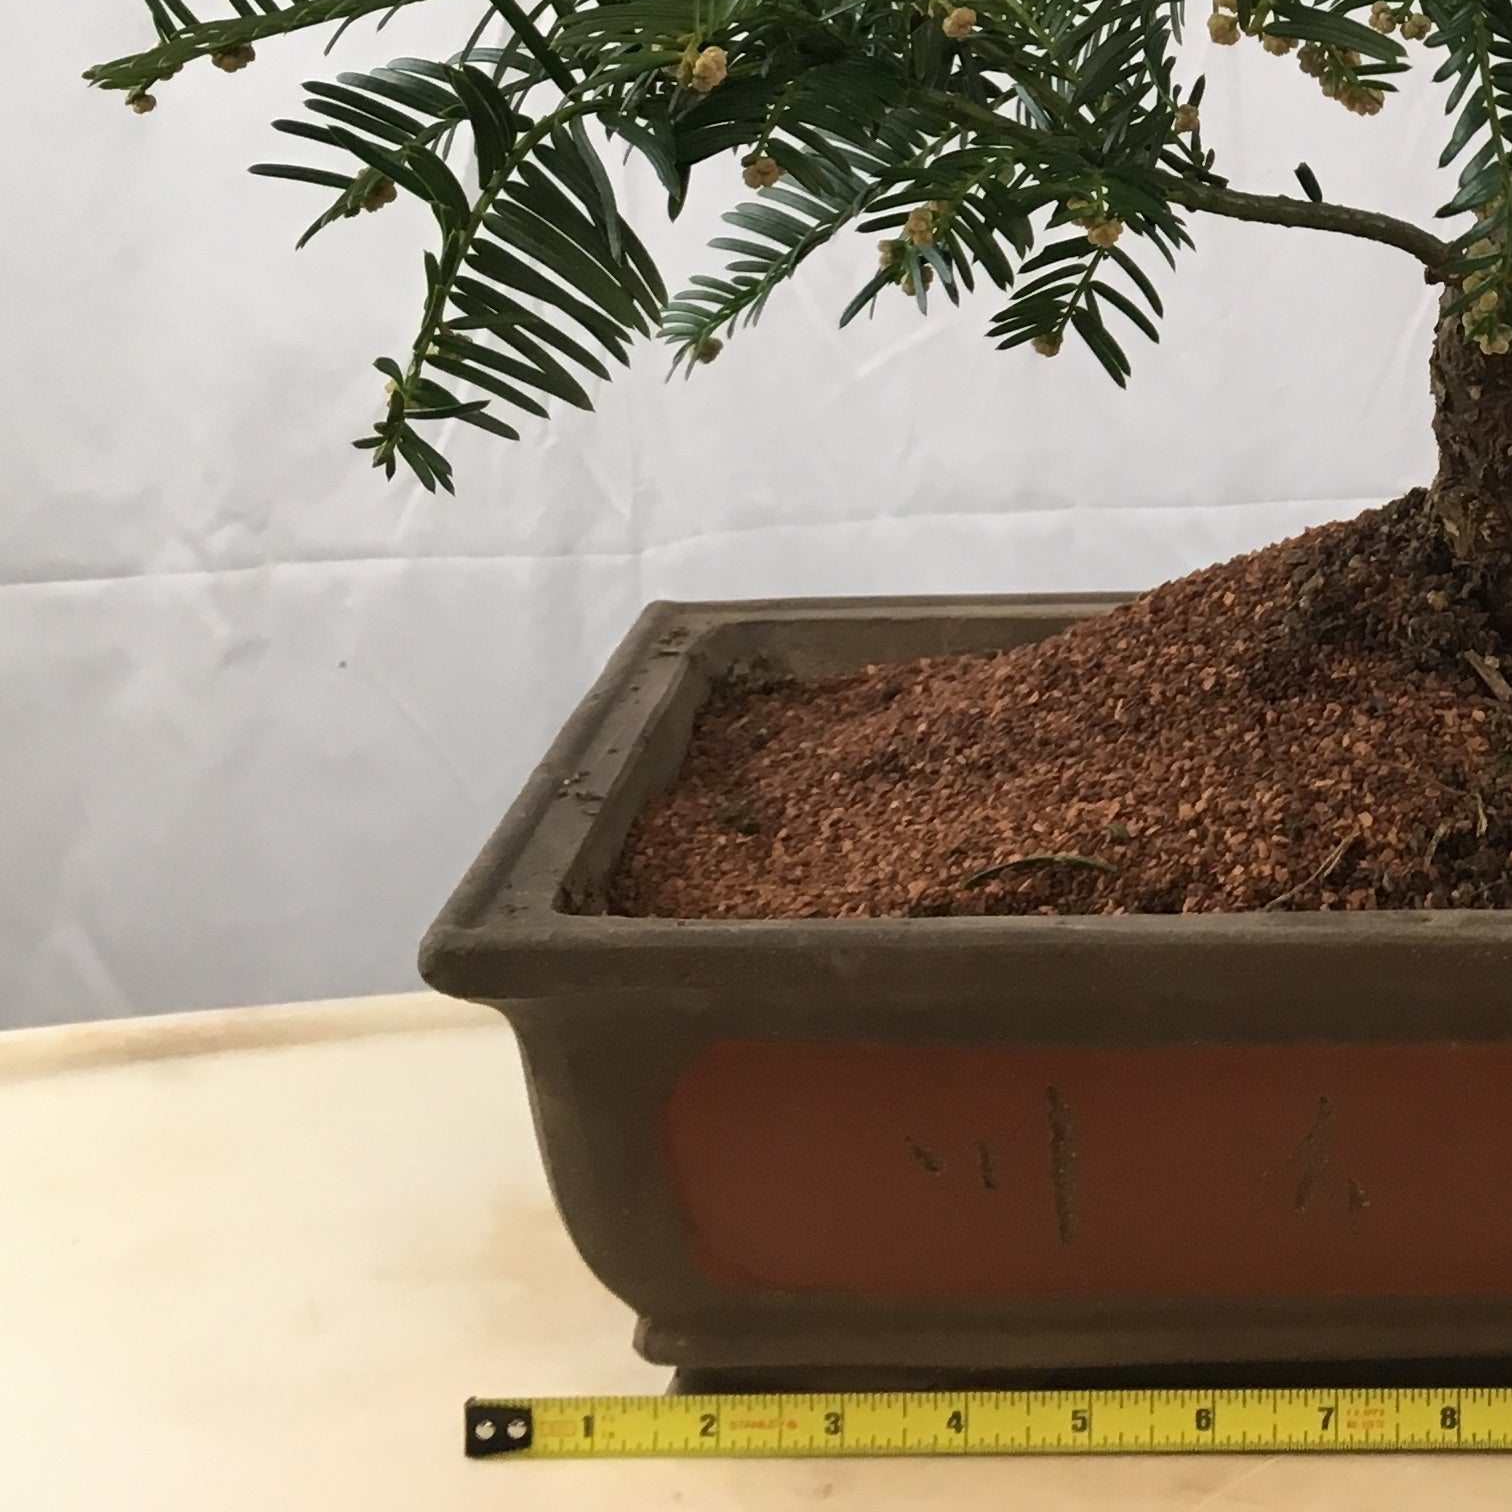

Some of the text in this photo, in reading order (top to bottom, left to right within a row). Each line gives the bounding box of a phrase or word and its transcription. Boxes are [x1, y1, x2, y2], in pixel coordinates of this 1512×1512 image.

[583, 1414, 594, 1438] 1
[700, 1413, 716, 1437] 2
[824, 1411, 841, 1436] 3
[946, 1410, 965, 1434] 4
[1071, 1409, 1088, 1434] 5
[1195, 1408, 1212, 1431] 6
[1318, 1406, 1335, 1431] 7
[1440, 1406, 1458, 1431] 8
